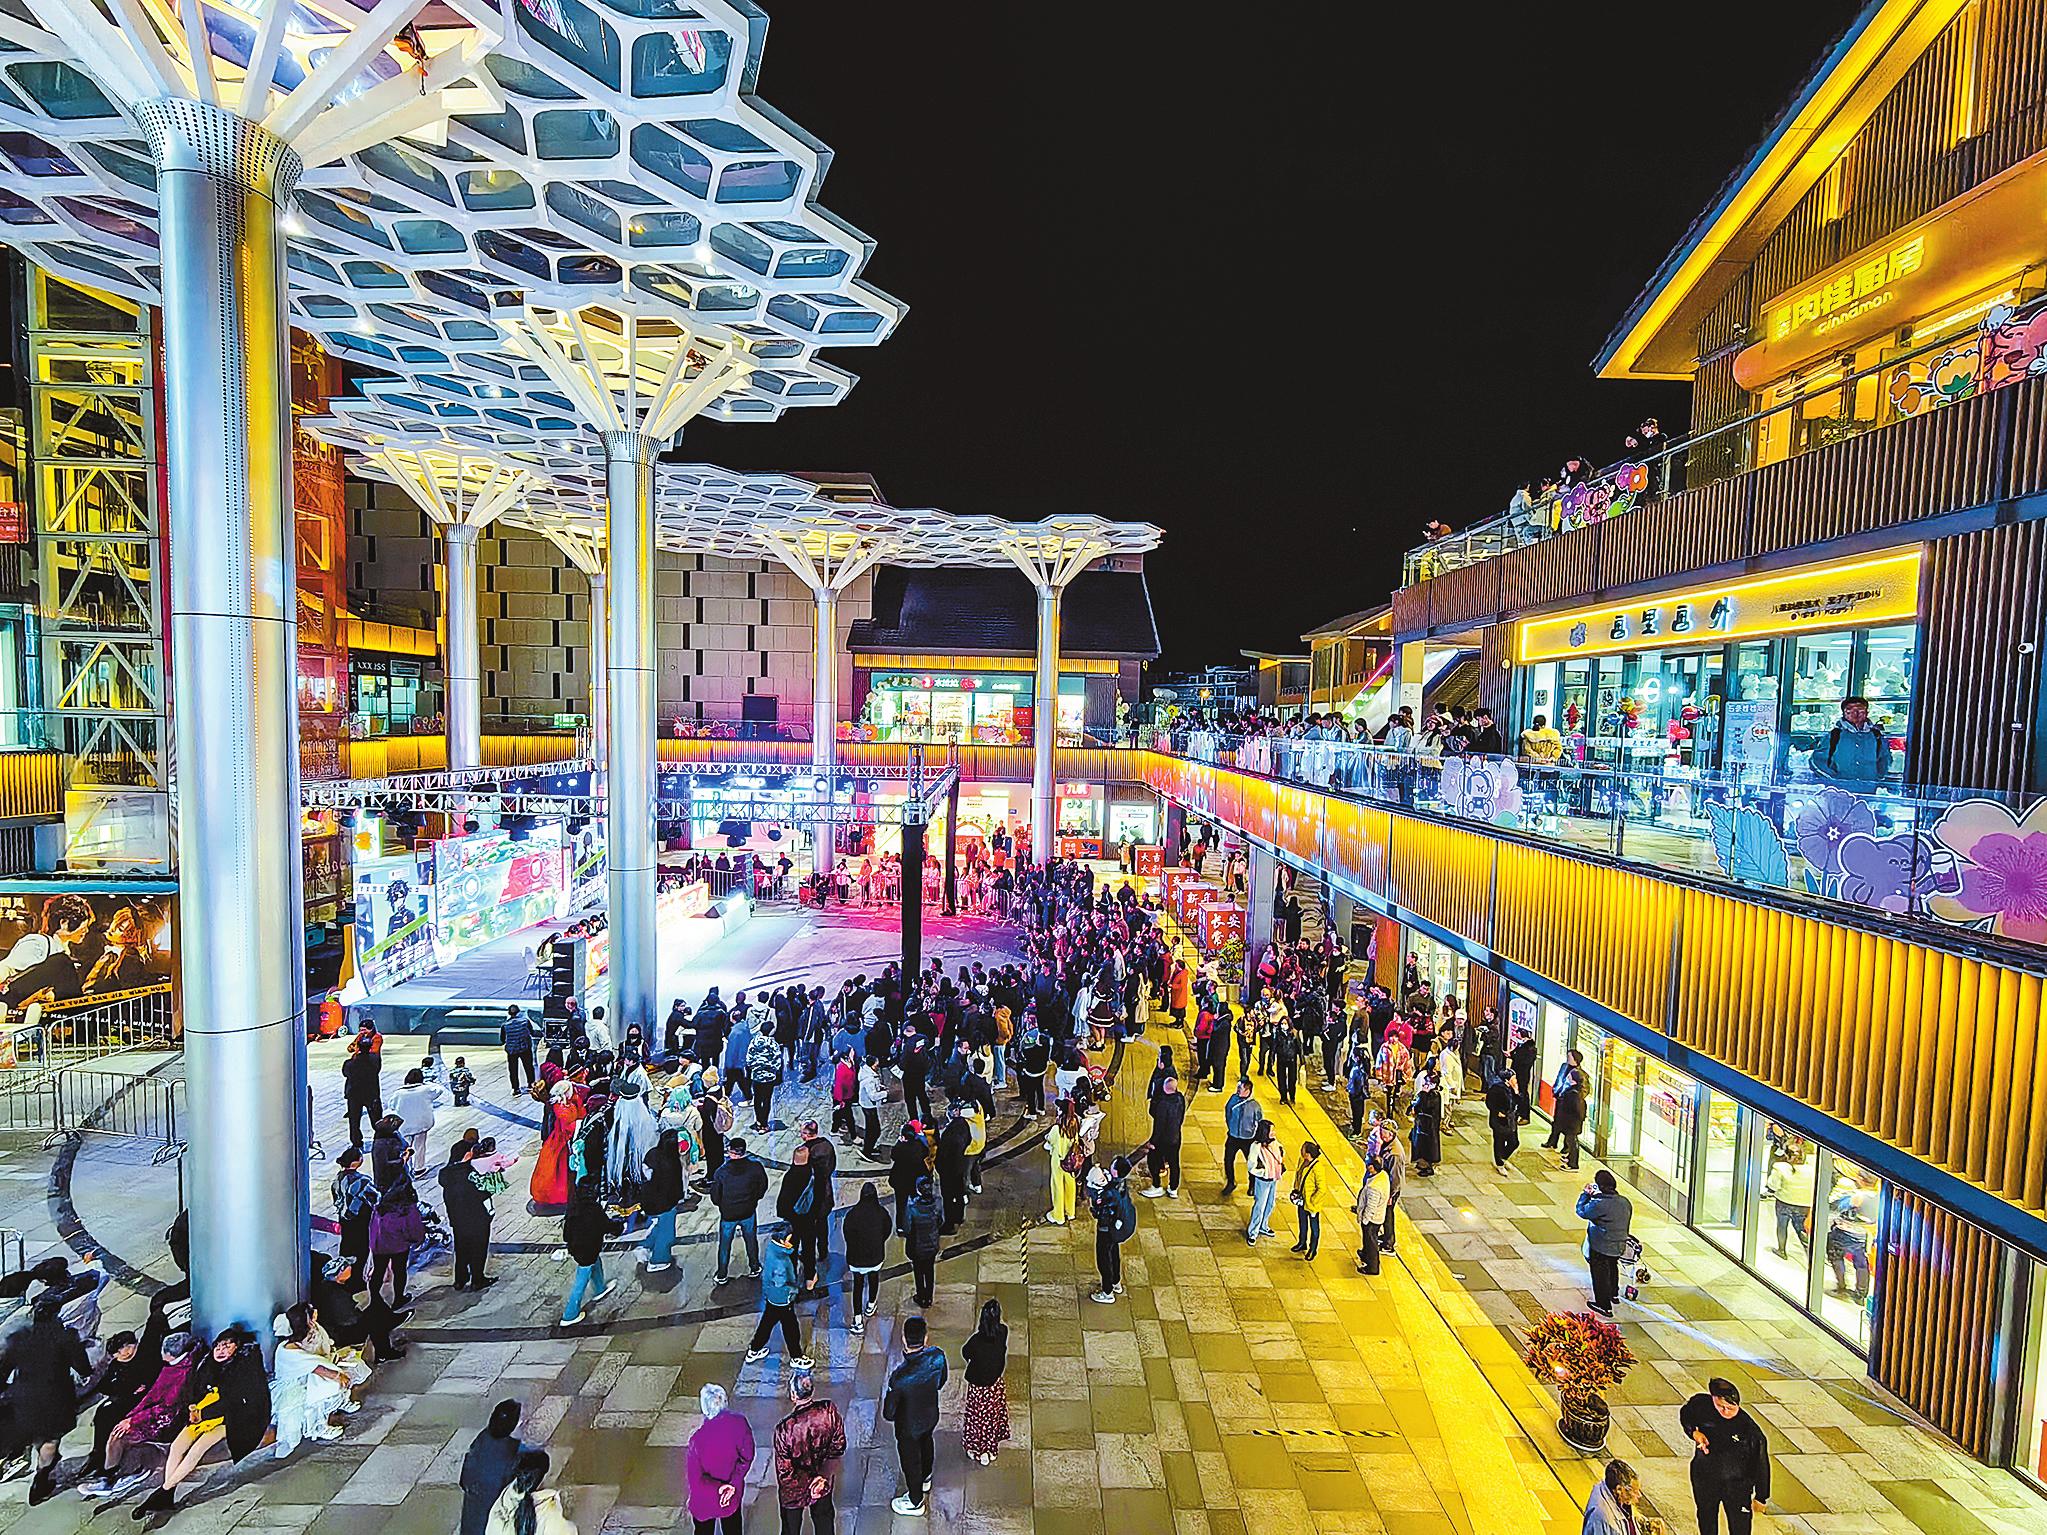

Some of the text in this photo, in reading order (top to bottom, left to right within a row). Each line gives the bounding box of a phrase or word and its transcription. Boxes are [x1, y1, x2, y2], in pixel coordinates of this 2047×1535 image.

[1791, 236, 1925, 331] 肉桂厨房
[1140, 852, 1161, 863] 大吉
[1186, 892, 1214, 906] 新年
[1211, 912, 1241, 929] 长安
[91, 994, 108, 1002] DAN
